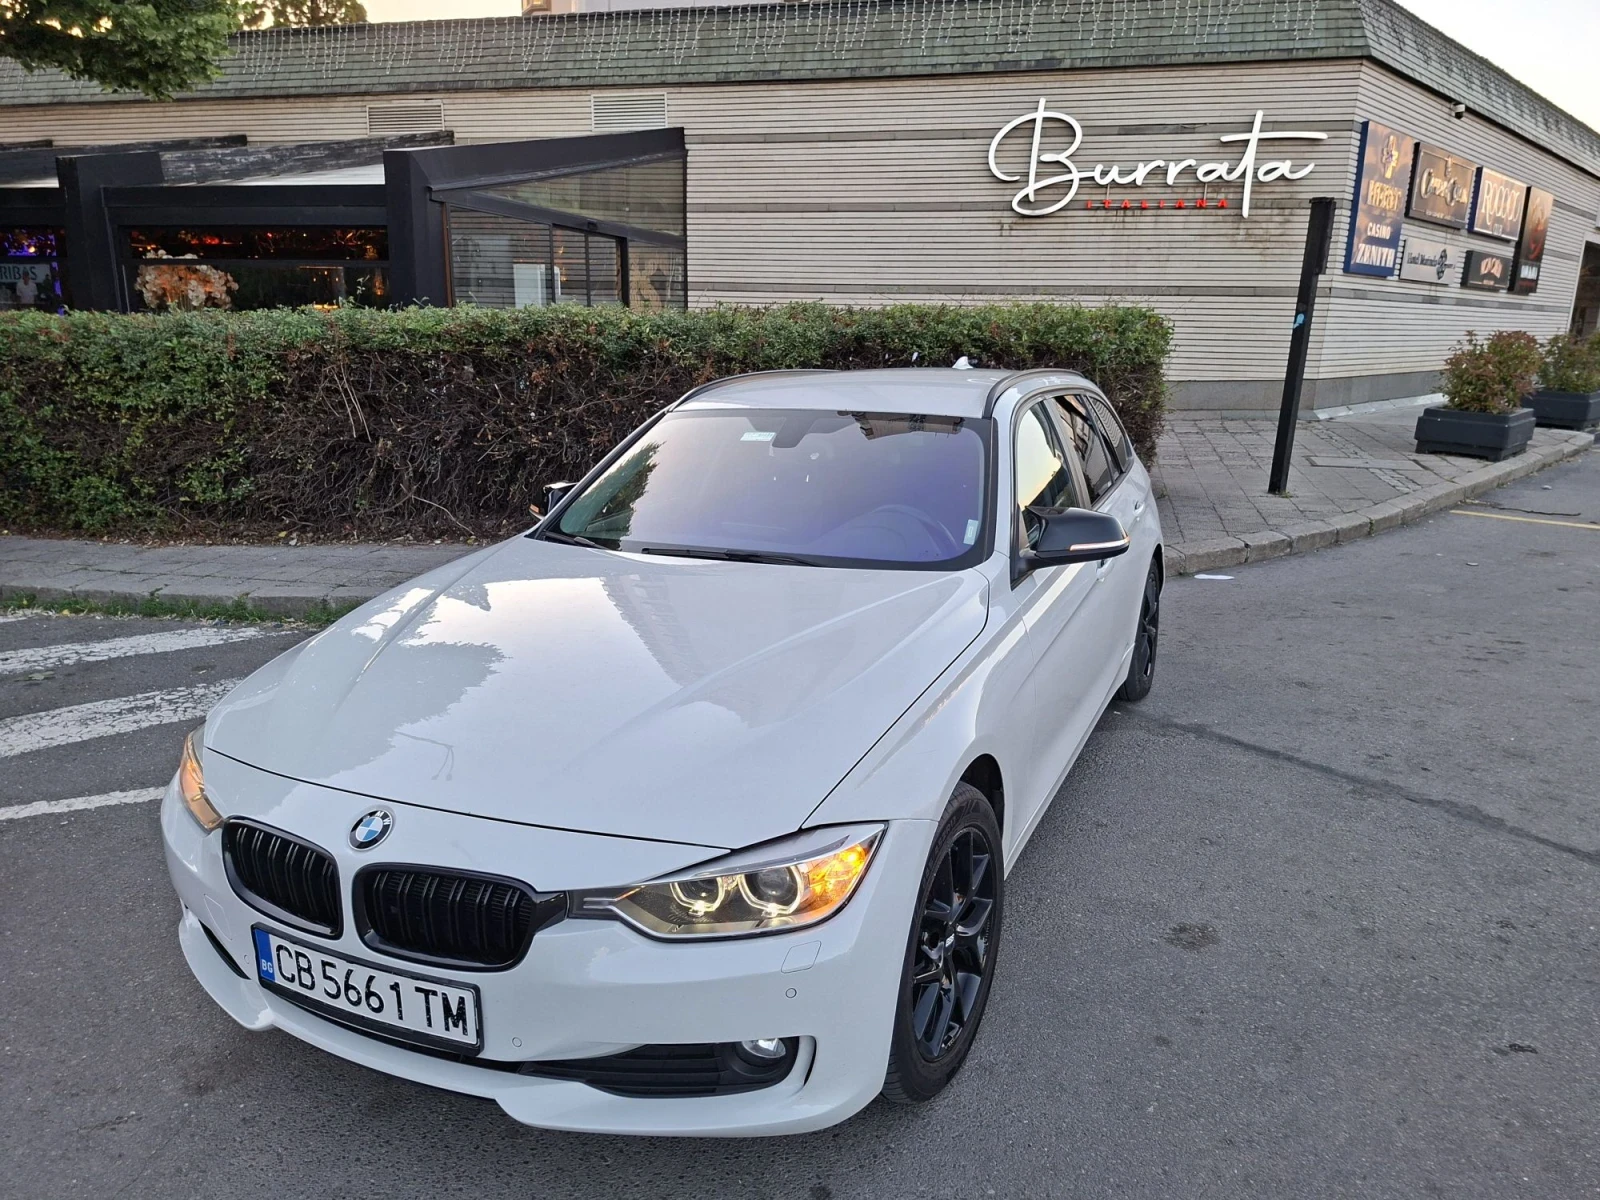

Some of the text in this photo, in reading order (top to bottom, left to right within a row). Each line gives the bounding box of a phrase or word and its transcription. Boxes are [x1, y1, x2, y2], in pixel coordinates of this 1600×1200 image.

[988, 97, 1329, 218] Burrata
[1086, 198, 1229, 209] ITALIANA
[1367, 222, 1391, 240] CASINO
[1356, 243, 1396, 268] ZENITH
[261, 959, 273, 973] BG
[276, 944, 468, 1036] CB 5661 TM
